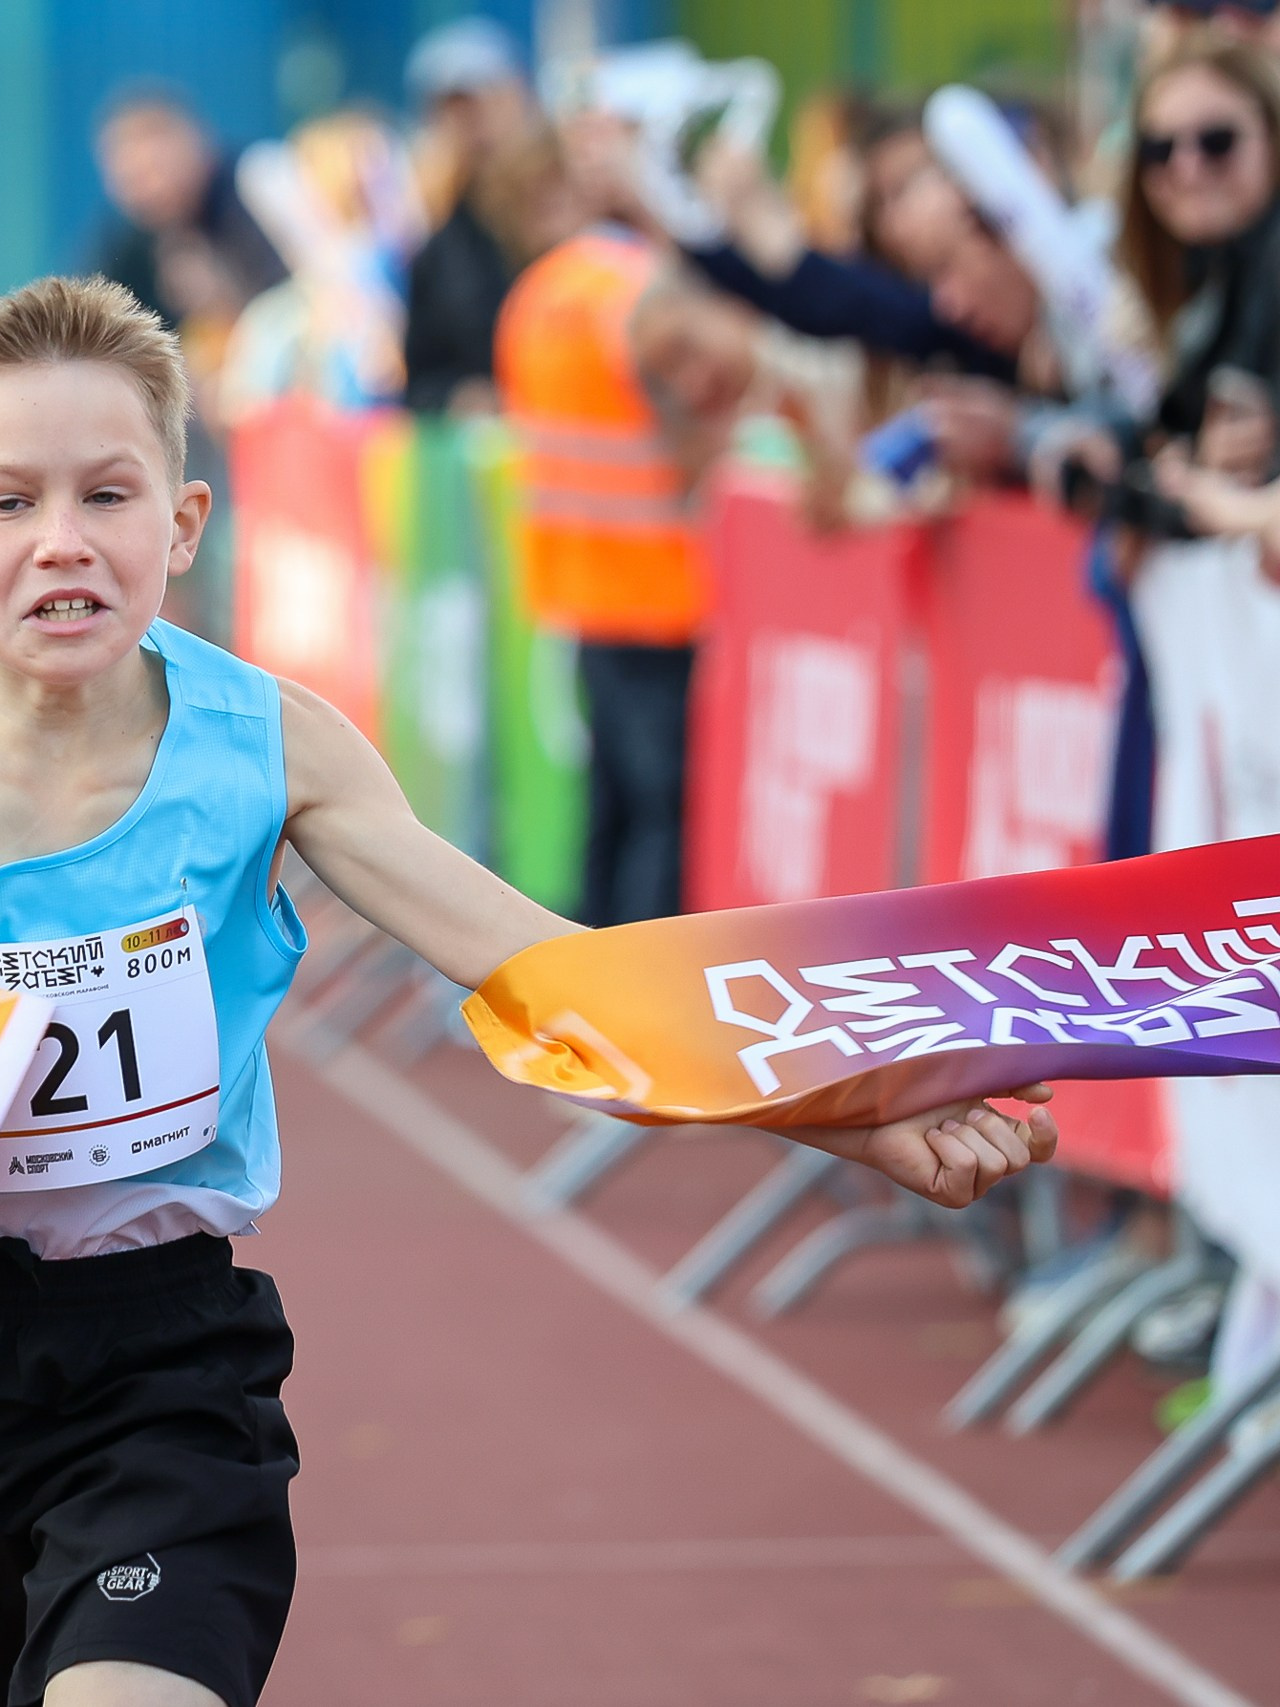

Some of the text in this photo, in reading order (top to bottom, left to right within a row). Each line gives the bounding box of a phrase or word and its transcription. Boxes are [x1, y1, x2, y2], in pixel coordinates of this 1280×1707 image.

[25, 1150, 74, 1164] МОСКОВСКИЙ
[27, 1163, 49, 1175] СПОРТ
[111, 1566, 148, 1578] SPORT
[106, 1579, 145, 1591] GEAR
